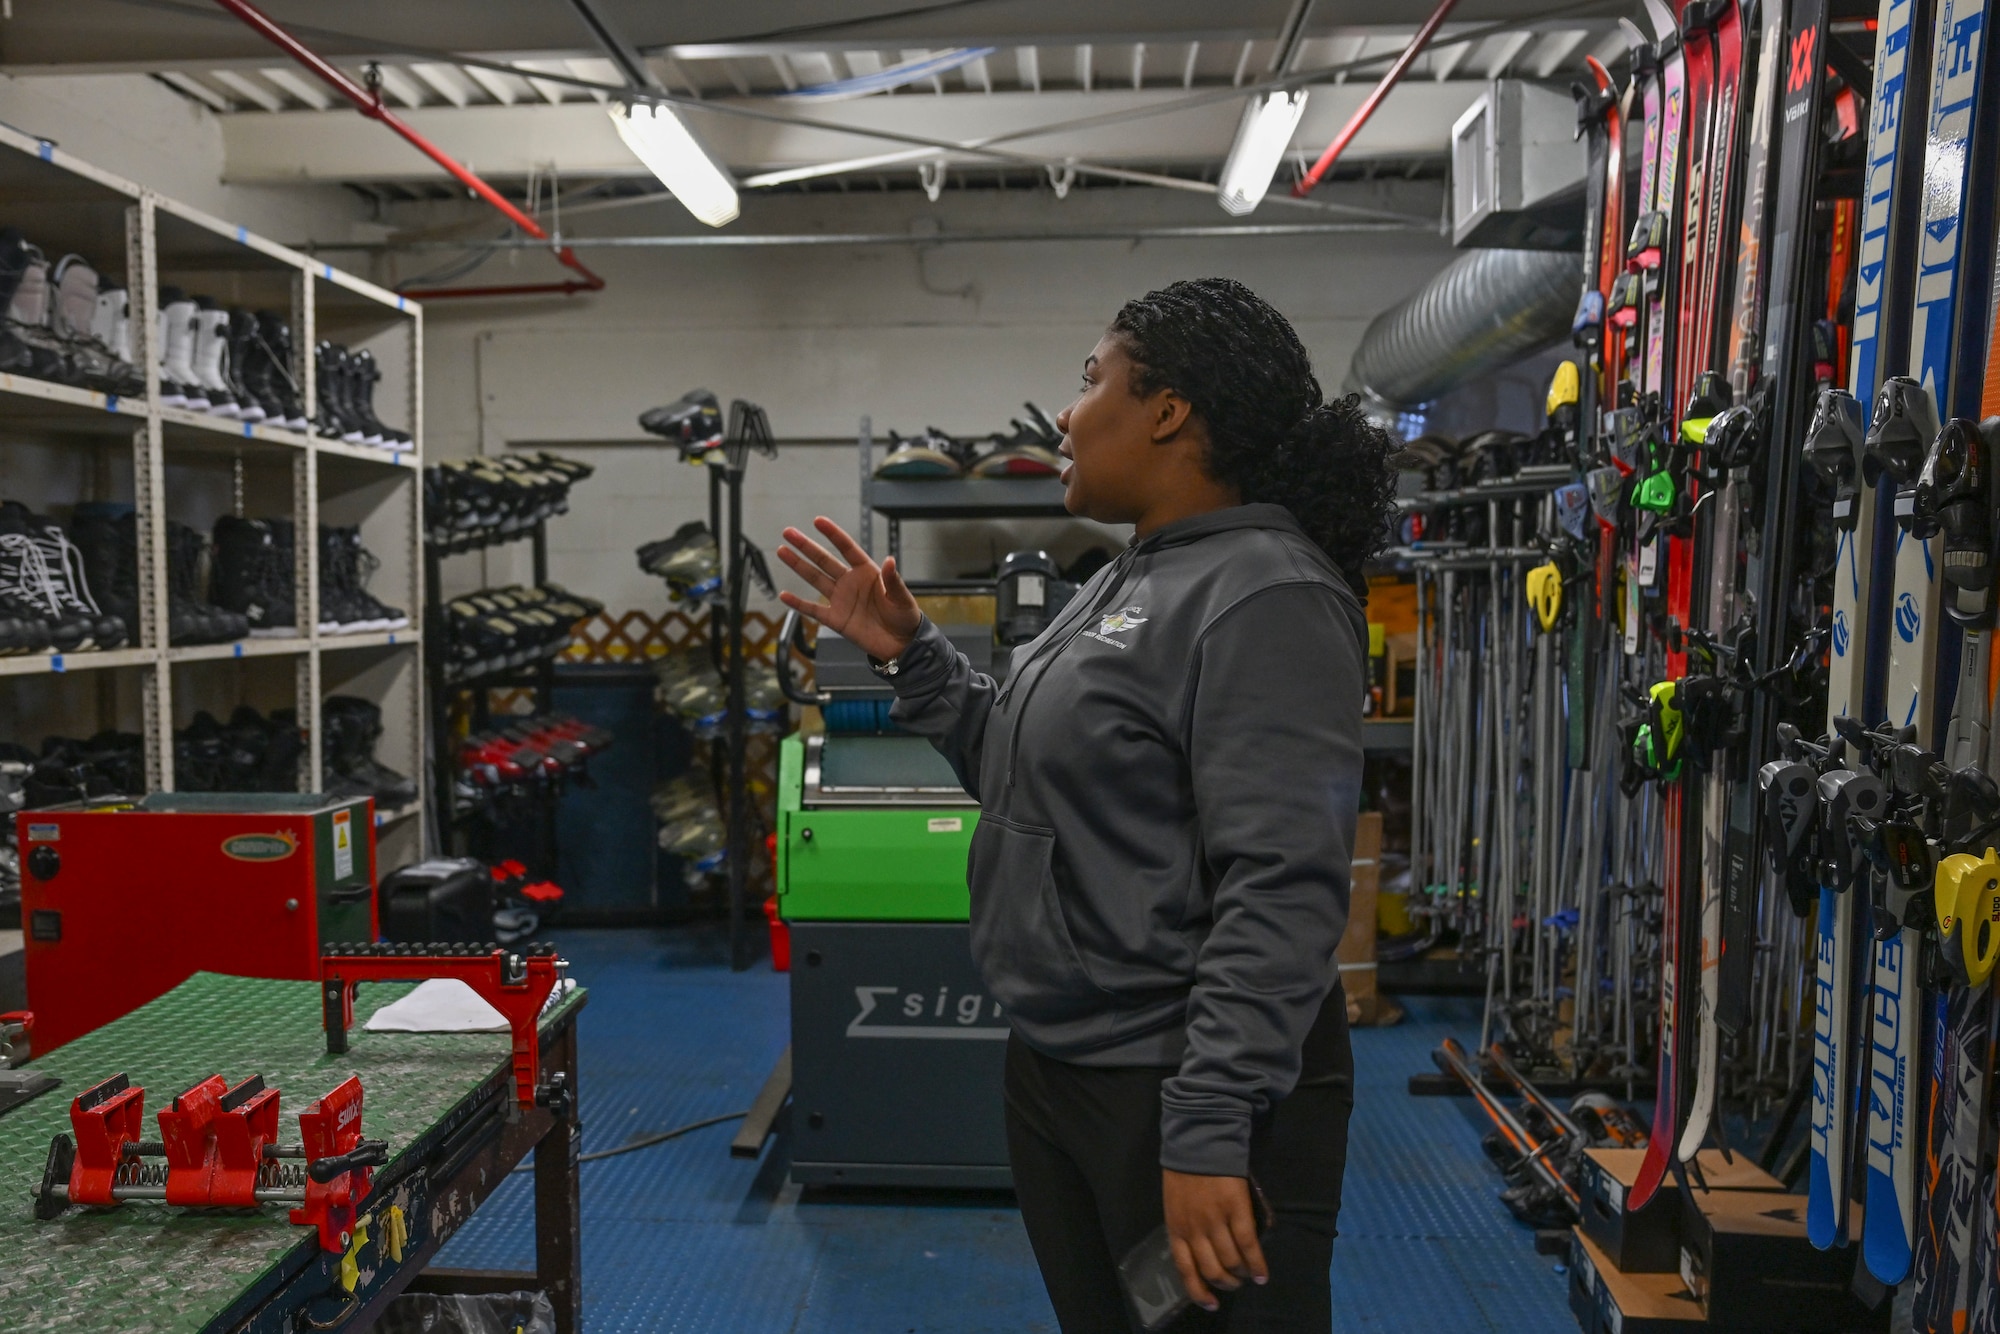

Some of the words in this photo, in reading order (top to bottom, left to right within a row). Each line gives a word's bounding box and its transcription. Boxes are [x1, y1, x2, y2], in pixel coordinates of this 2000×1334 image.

[1785, 98, 1809, 123] Völkl
[1854, 0, 1911, 343] KINETI
[1894, 385, 1905, 417] LOOK
[1811, 935, 1835, 1160] RACE
[1867, 938, 1904, 1179] RACE
